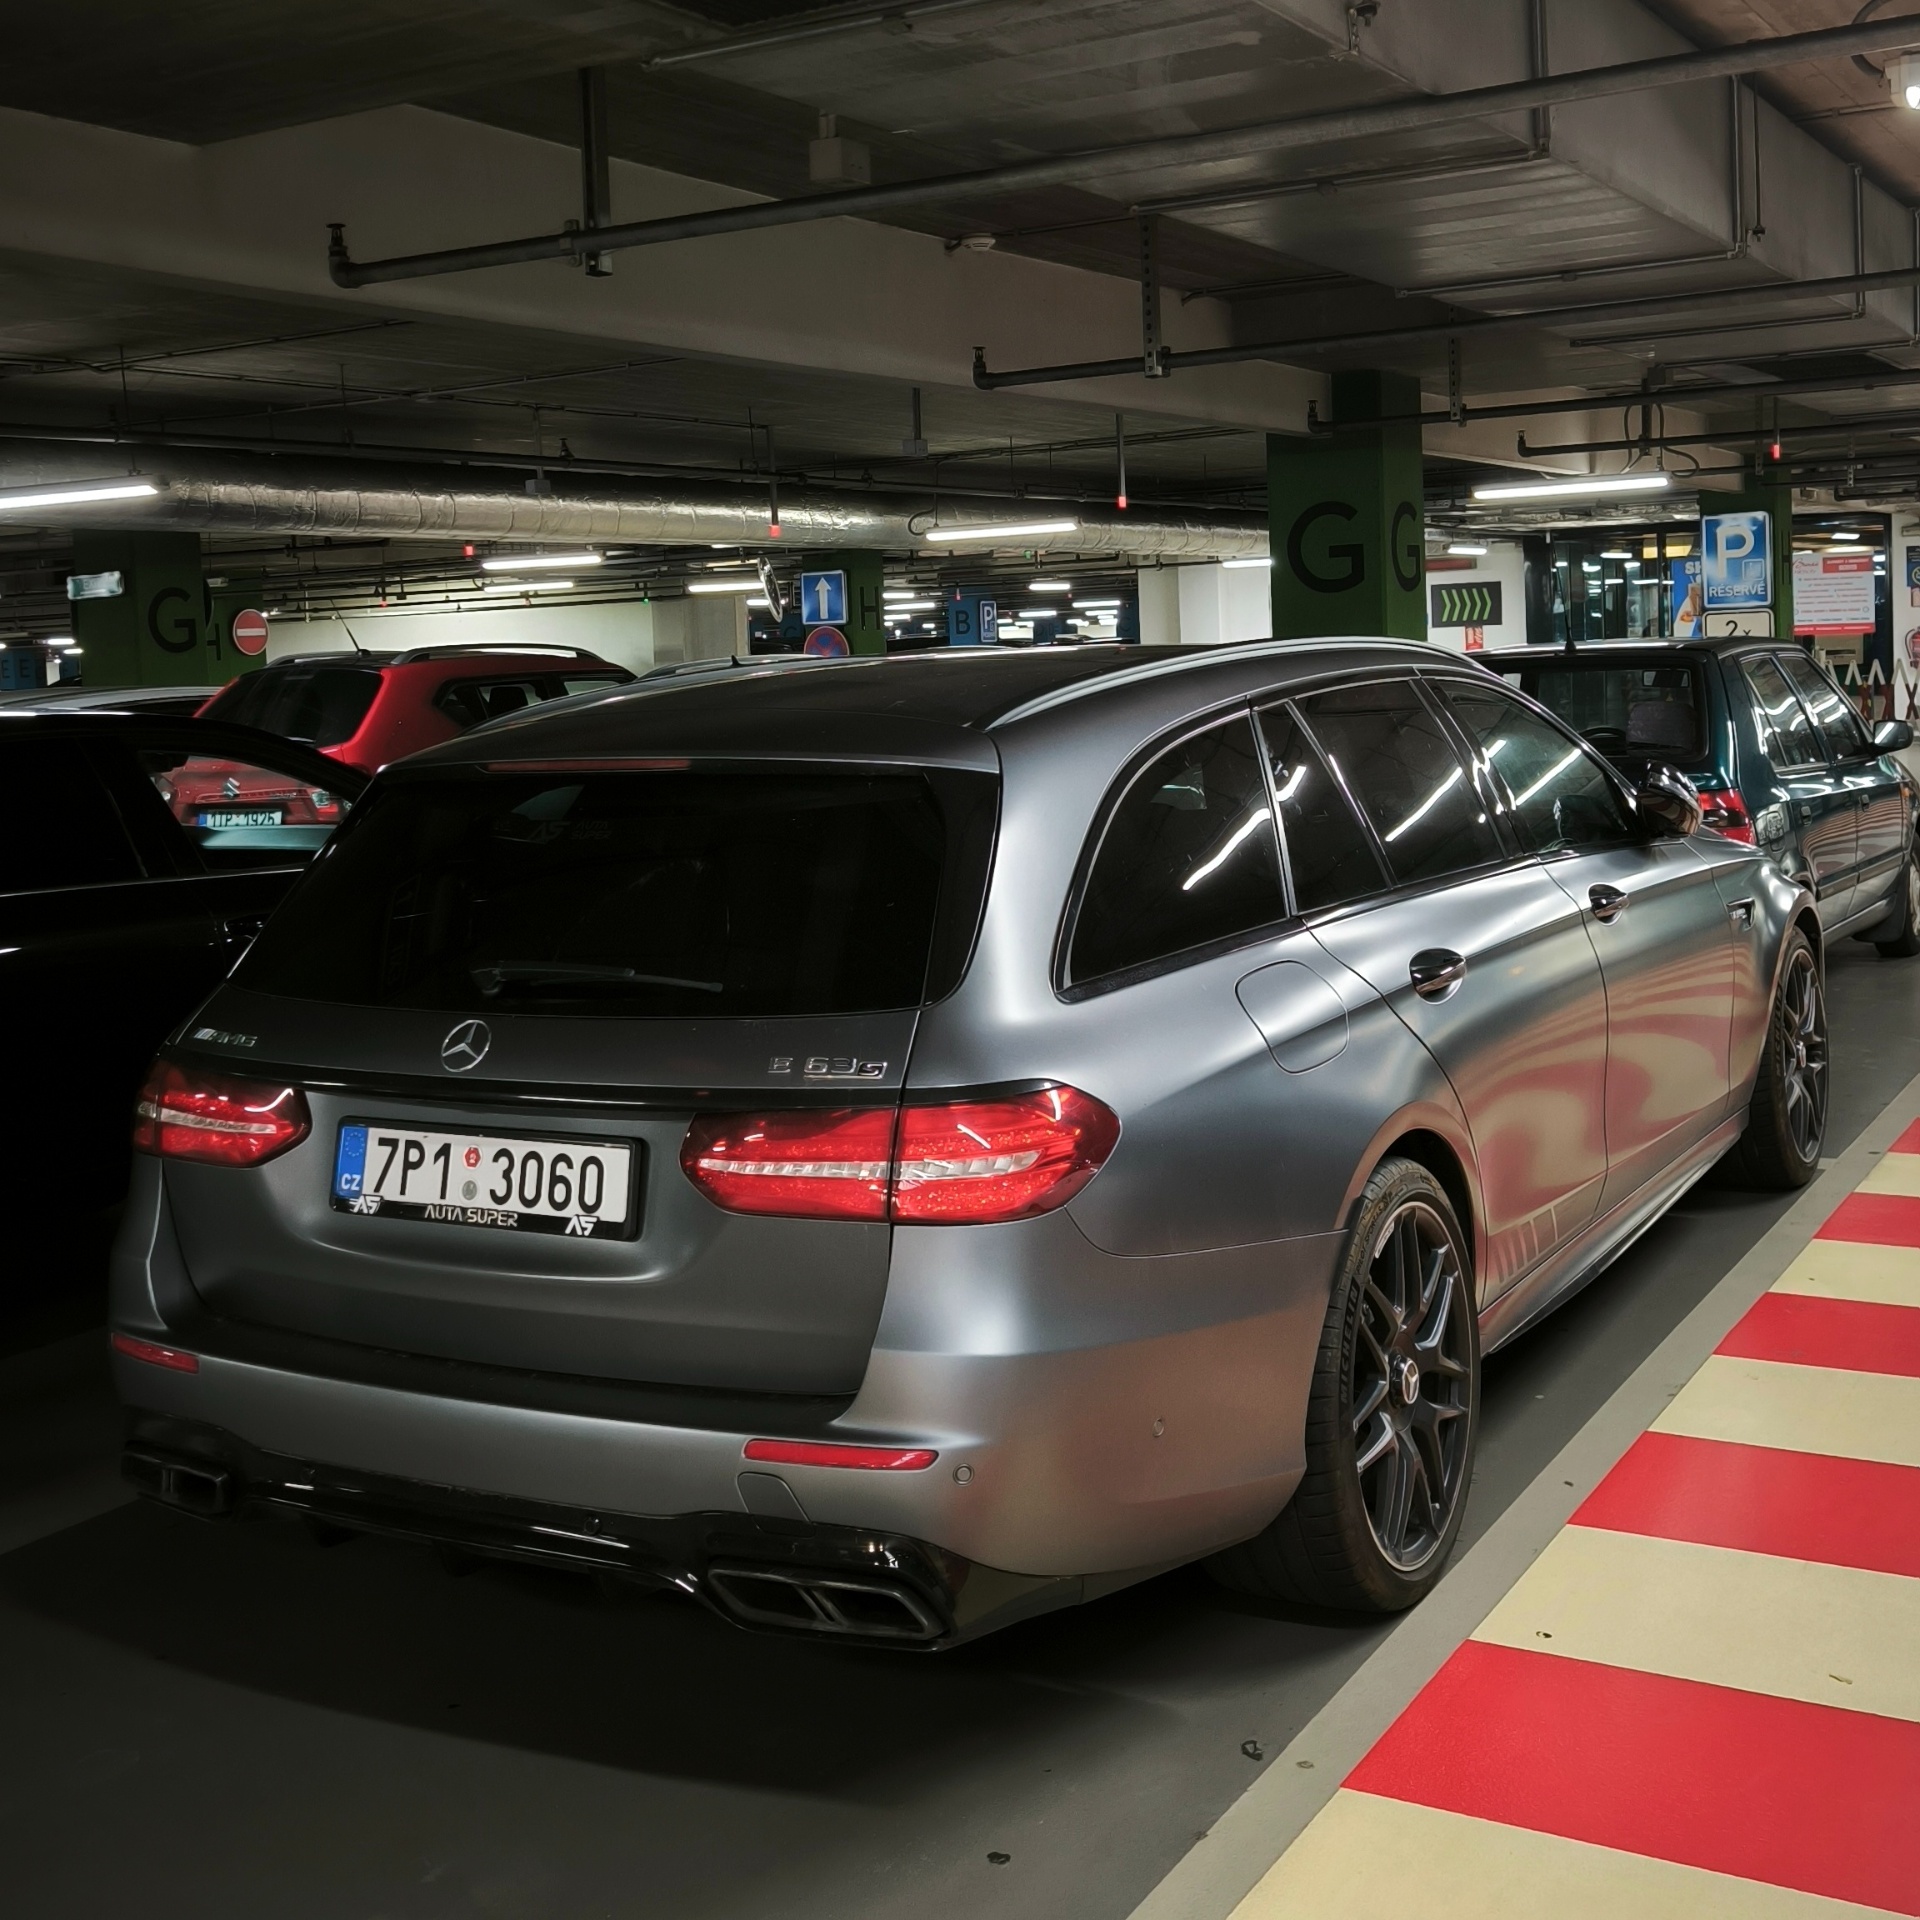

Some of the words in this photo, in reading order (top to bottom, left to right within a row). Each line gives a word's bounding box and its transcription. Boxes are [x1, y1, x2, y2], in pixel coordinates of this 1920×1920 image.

[1287, 500, 1365, 593] G
[1391, 501, 1421, 592] G
[1716, 525, 1755, 580] P
[859, 586, 881, 630] H
[1709, 581, 1766, 598] RÉSERVÉ
[148, 587, 197, 653] G
[955, 610, 971, 635] B
[20, 659, 31, 678] E
[767, 1056, 794, 1074] E
[340, 1173, 360, 1191] CZ
[372, 1137, 452, 1200] 7P1
[489, 1147, 605, 1215] 3060
[424, 1204, 463, 1223] AUTA
[466, 1209, 518, 1228] SUPER
[1340, 1281, 1360, 1404] MICHELIN
